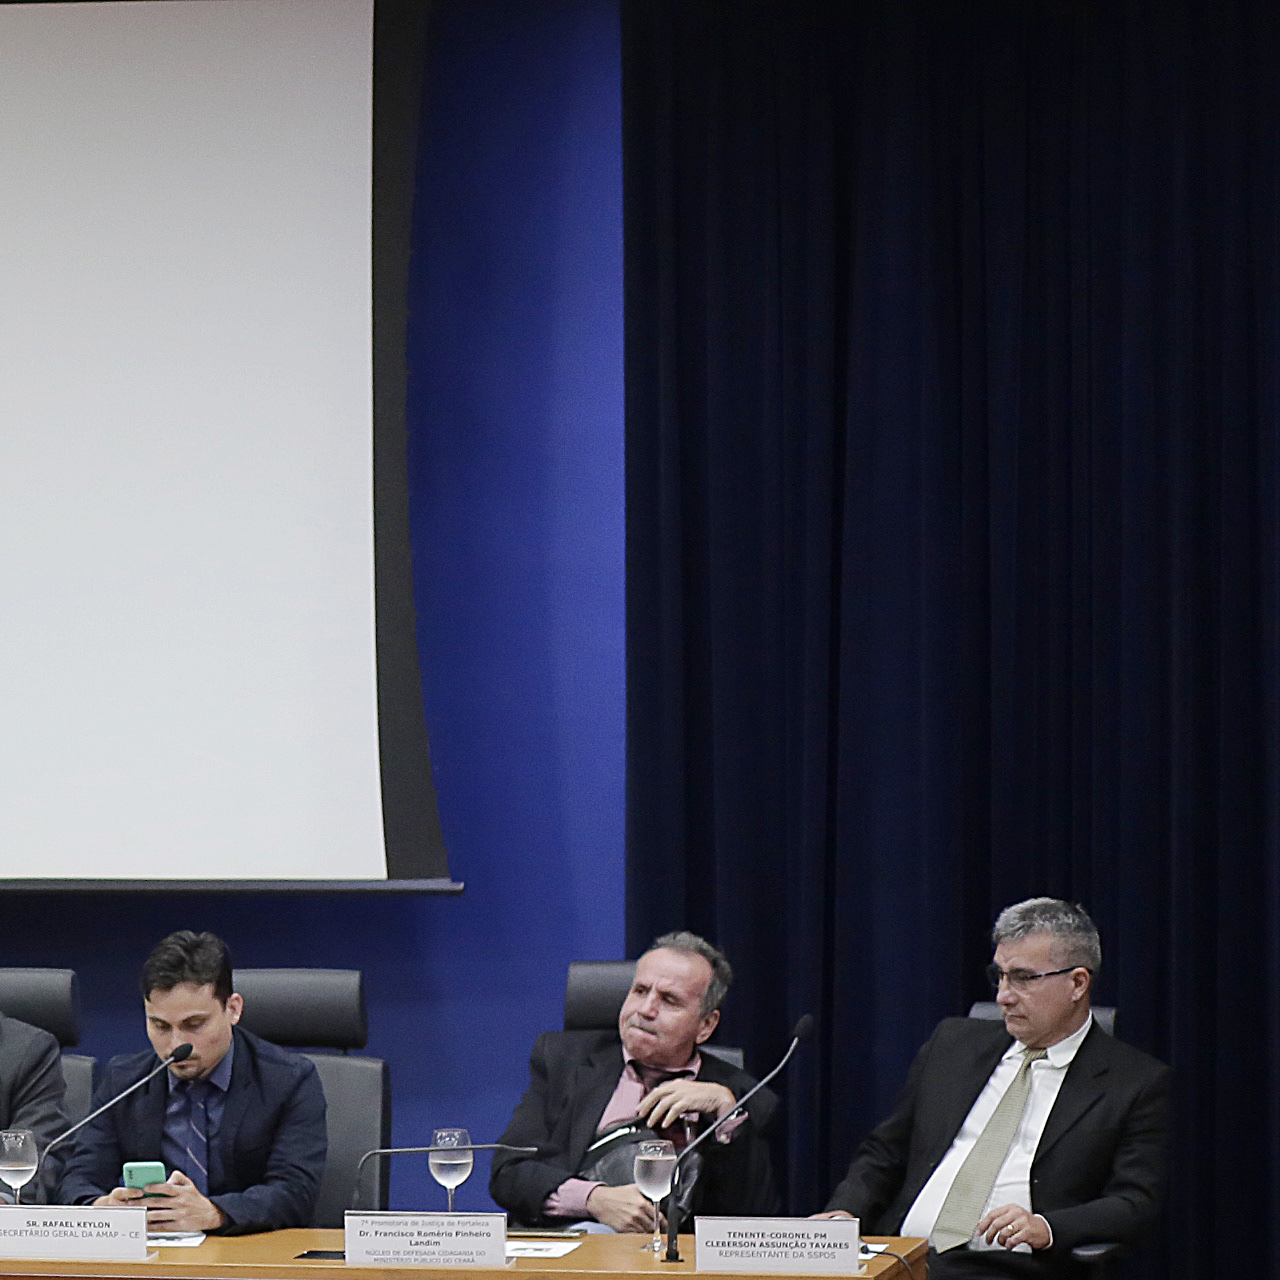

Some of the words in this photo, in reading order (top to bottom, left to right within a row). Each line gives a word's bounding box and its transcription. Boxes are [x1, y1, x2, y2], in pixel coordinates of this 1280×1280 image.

[52, 1230, 79, 1238] GERAL
[82, 1230, 93, 1238] DA
[129, 1231, 139, 1239] CE
[455, 1230, 491, 1238] Pinheiro
[727, 1231, 811, 1239] TENENTE-CORONEL
[705, 1240, 756, 1248] CLEBERSON
[759, 1240, 806, 1250] ASSUNÇÃO
[719, 1250, 789, 1258] REPRESENTANTE
[792, 1251, 805, 1259] DA
